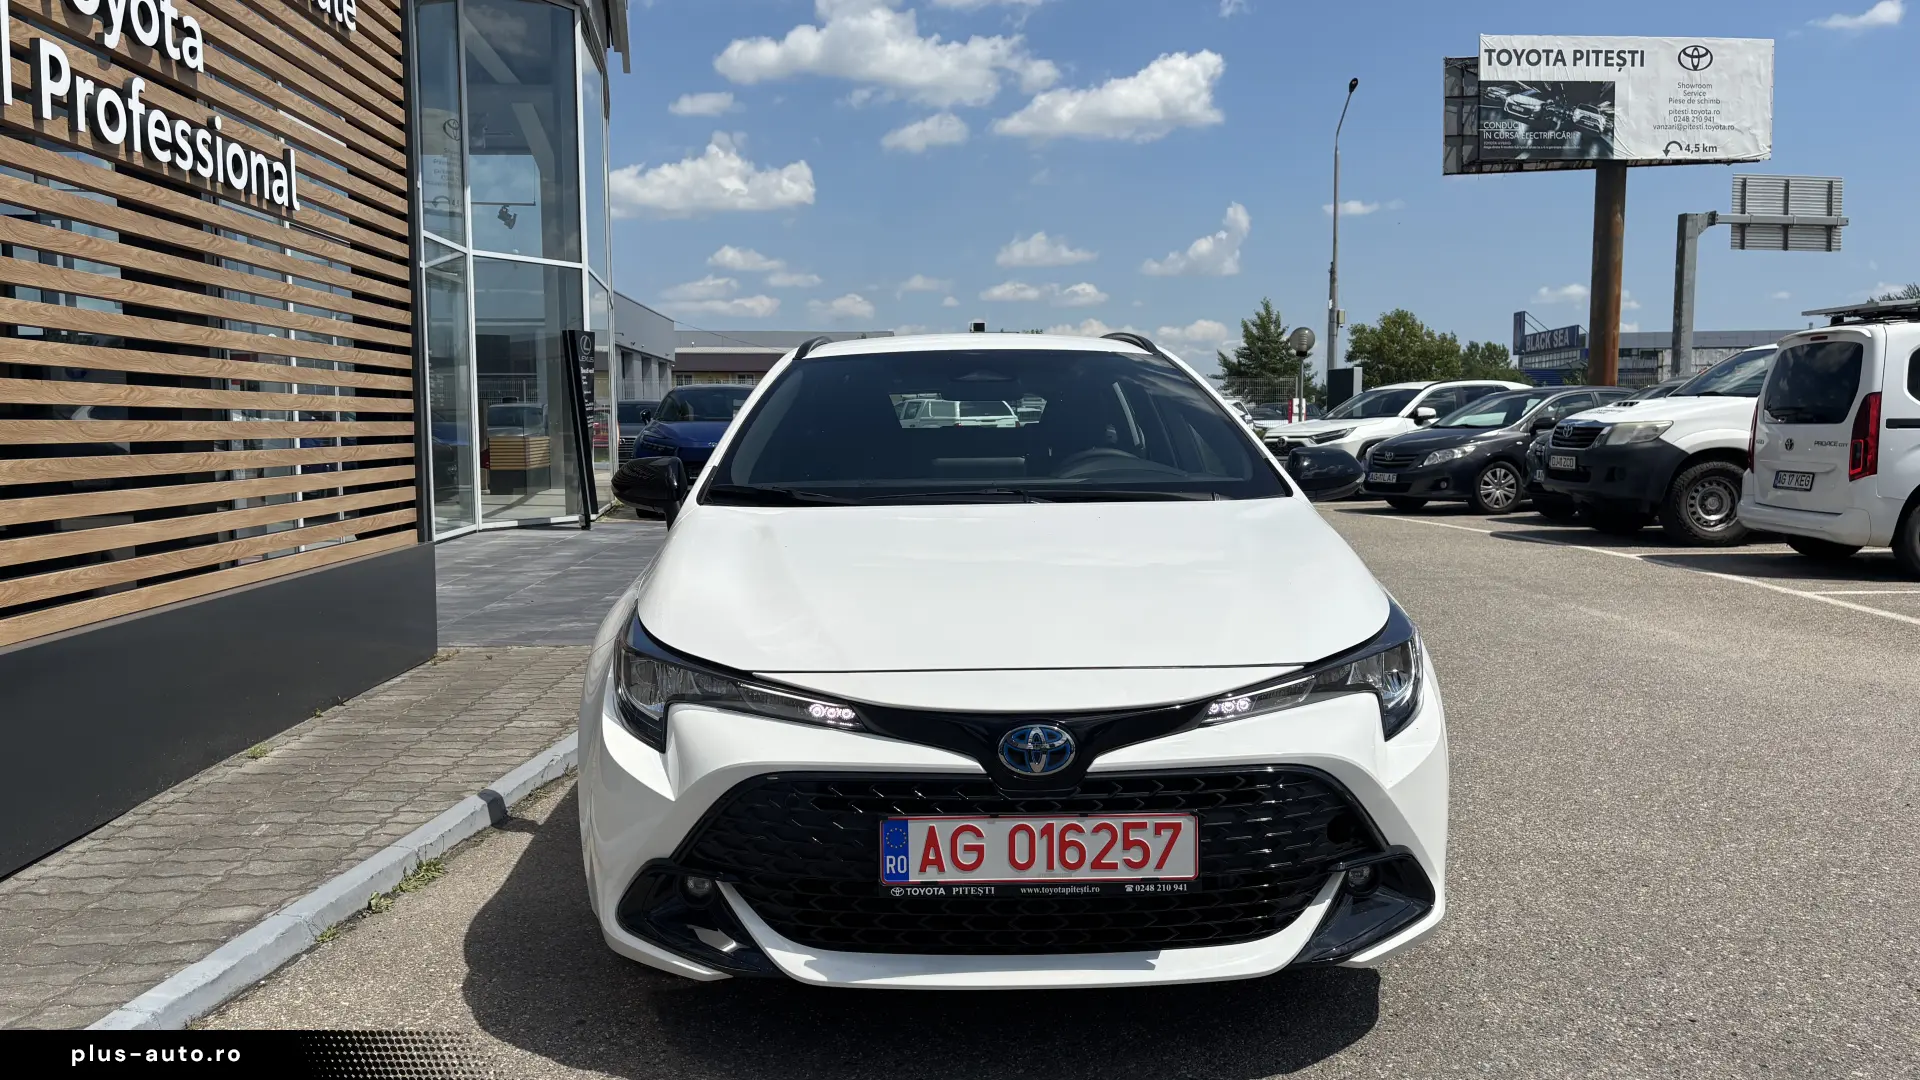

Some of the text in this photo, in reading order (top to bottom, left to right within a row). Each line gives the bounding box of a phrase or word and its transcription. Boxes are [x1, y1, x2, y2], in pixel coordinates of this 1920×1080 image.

[73, 0, 205, 73] yota
[1484, 49, 1645, 72] TOYOTA PITEȘTI
[1677, 81, 1713, 89] Showroom
[1668, 97, 1721, 105] Piese de schimb
[38, 38, 301, 212] Professional
[1673, 115, 1715, 123] 0248 210 941
[1684, 143, 1718, 154] 4,5 km
[1526, 328, 1570, 352] BLACK SEA
[1795, 474, 1811, 486] KEG
[918, 820, 1183, 873] AG 016257
[886, 855, 907, 874] RO
[906, 887, 946, 896] TOYOTA
[1135, 884, 1155, 892] 0248
[1156, 883, 1172, 892] 210
[1173, 883, 1187, 892] 941
